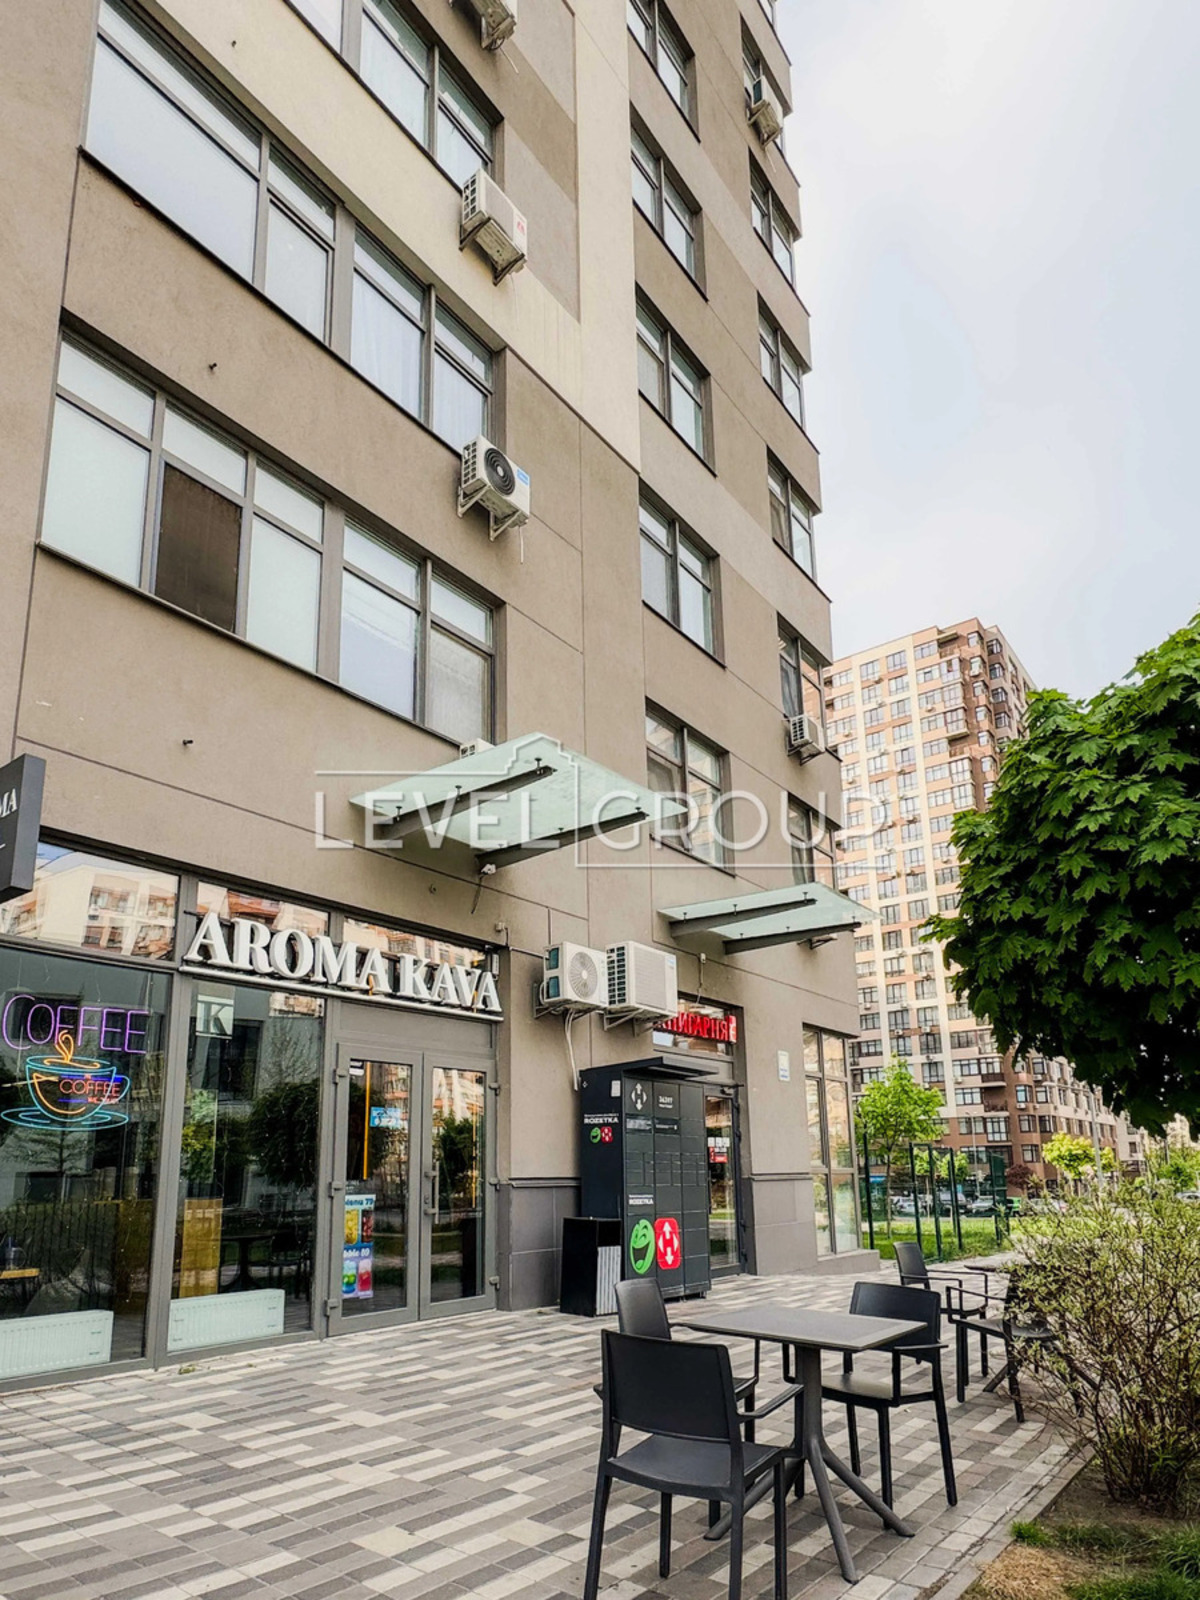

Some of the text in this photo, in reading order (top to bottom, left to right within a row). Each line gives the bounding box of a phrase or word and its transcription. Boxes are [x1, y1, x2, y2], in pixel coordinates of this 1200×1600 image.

[183, 912, 503, 1013] AROMA KAVA
[2, 994, 149, 1055] COFFEE
[59, 1079, 121, 1097] COFFEE
